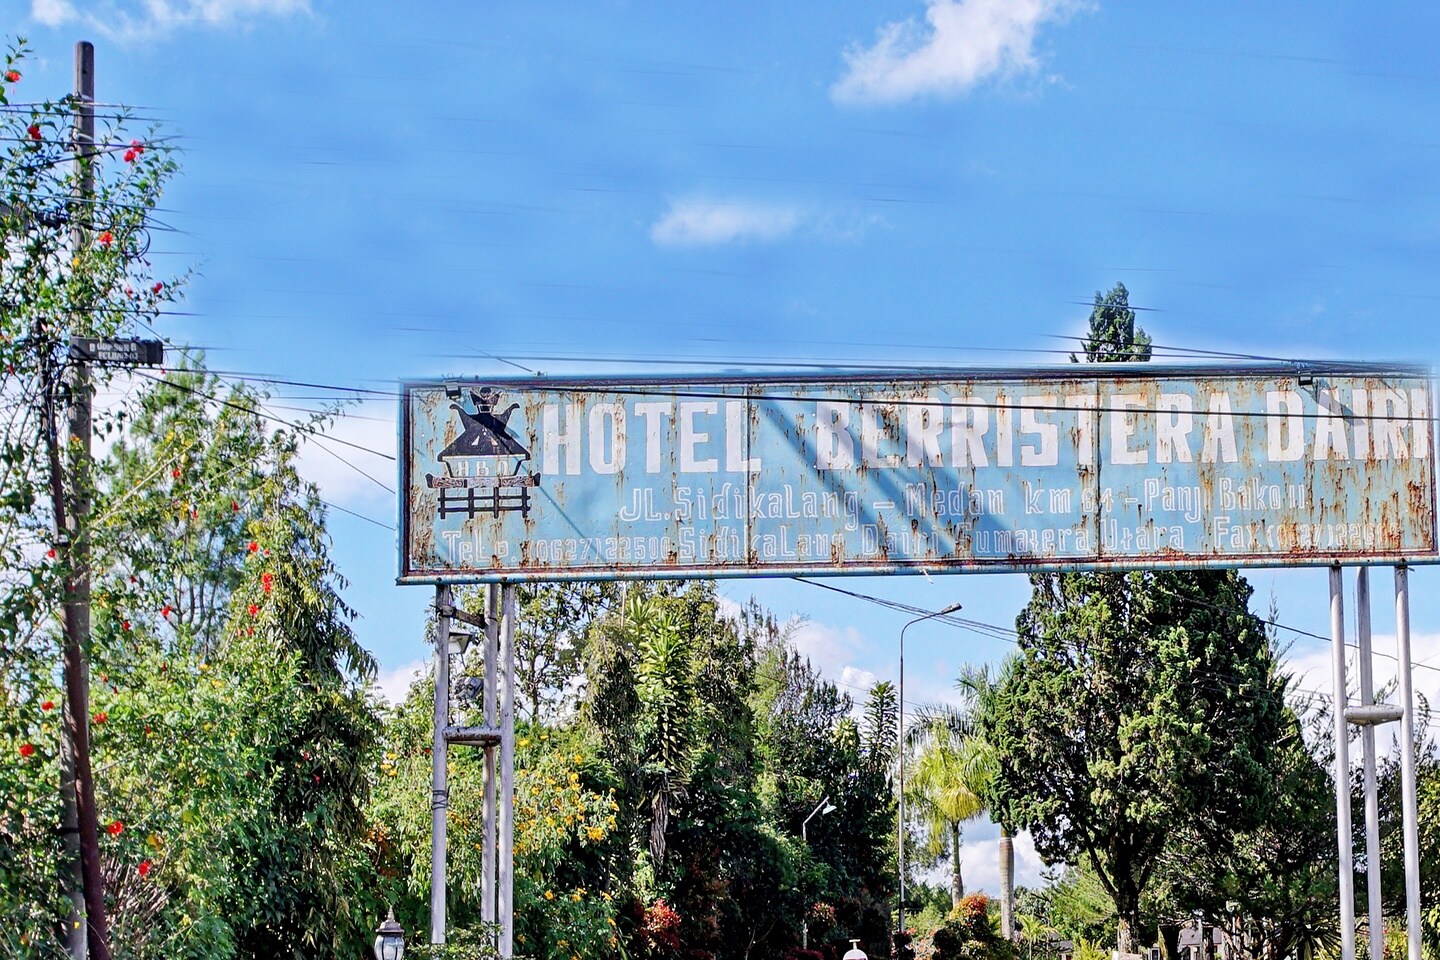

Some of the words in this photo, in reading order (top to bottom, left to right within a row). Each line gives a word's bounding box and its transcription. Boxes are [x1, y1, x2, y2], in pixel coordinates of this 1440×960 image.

[543, 402, 762, 475] HOTEL
[816, 390, 1238, 471] BERRISTERA
[1266, 388, 1428, 463] DAIRI
[905, 481, 1005, 517] Medan
[1099, 519, 1185, 551] Utara
